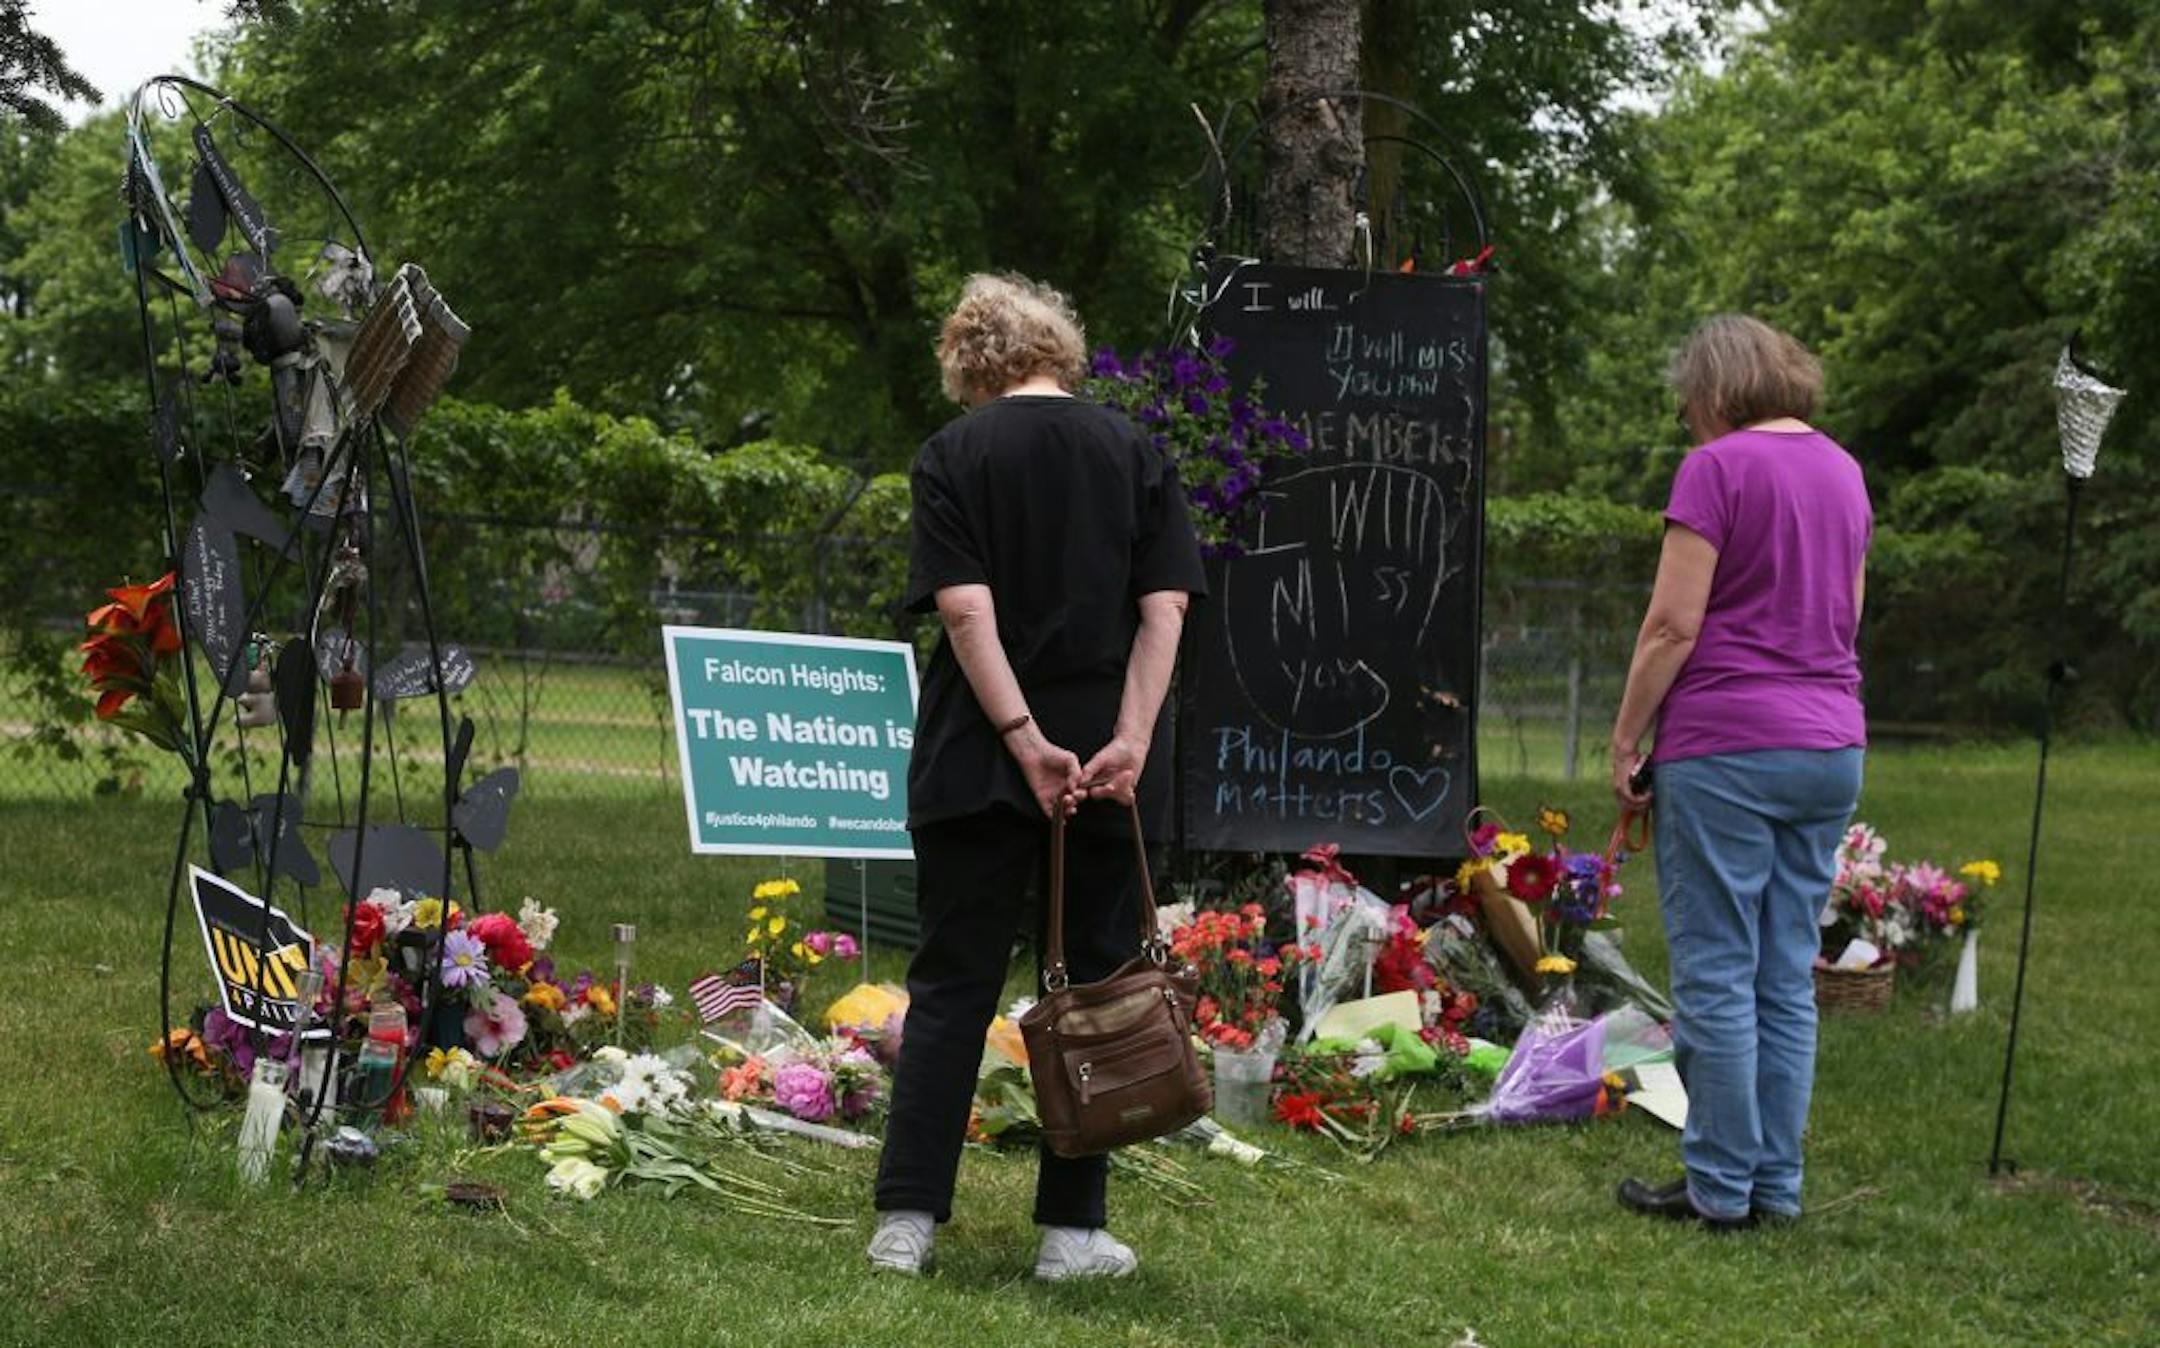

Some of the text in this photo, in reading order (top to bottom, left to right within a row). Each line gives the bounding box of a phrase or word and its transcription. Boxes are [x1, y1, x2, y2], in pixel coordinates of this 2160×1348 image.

[704, 657, 886, 696] Falcon Heights:
[686, 707, 914, 751] The Nation is
[728, 755, 890, 800] Watching
[828, 815, 907, 833] #wecandobe
